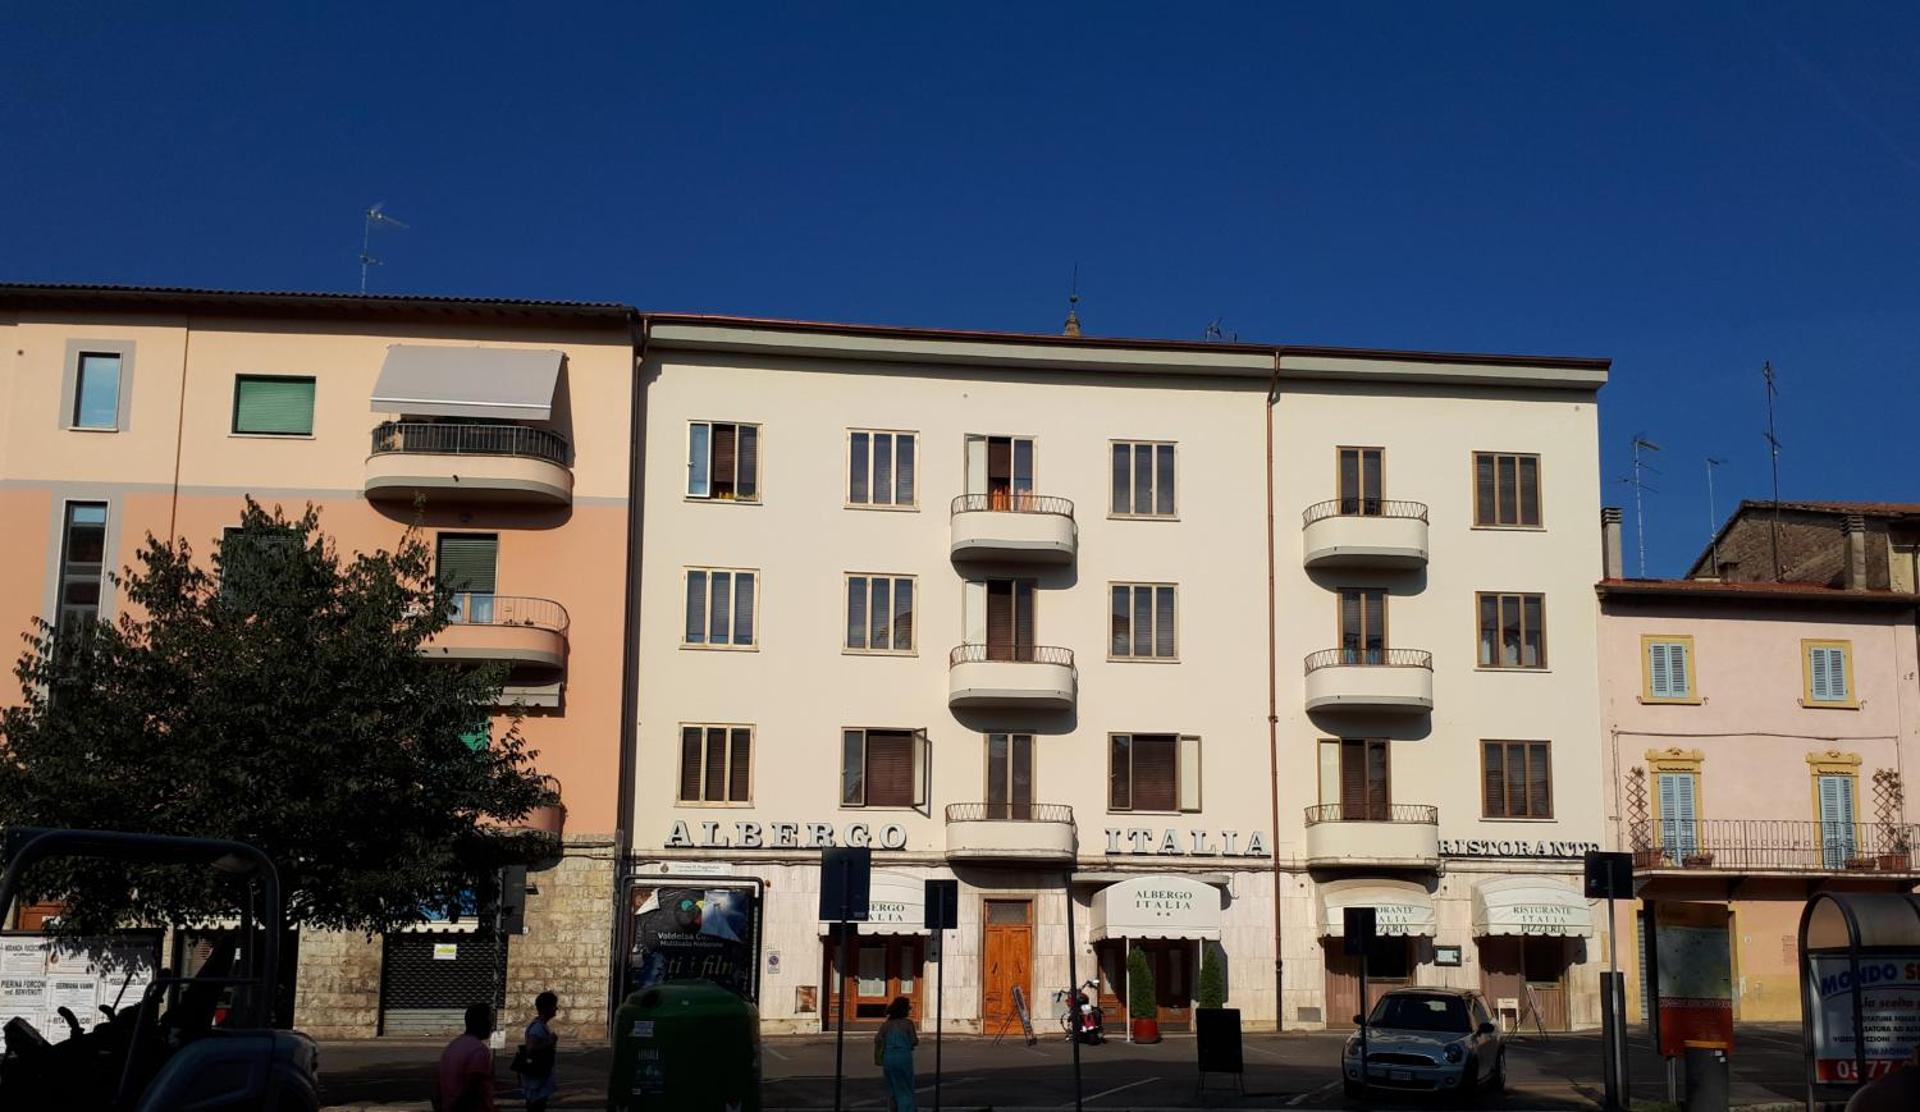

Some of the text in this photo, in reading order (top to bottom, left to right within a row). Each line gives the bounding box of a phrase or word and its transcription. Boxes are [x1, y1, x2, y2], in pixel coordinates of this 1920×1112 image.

[664, 819, 908, 850] ALBERGO
[1105, 828, 1272, 858] ITALIA
[1437, 839, 1600, 859] RISTORANTE
[1135, 890, 1193, 900] ALBERGO
[871, 903, 905, 912] ERGO
[1135, 900, 1192, 910] ITALIA
[1376, 906, 1414, 914] ORANTE
[1513, 906, 1570, 915] RISTORANTE
[869, 913, 904, 921] ALIA
[1522, 915, 1566, 923] ITALIA
[1378, 924, 1410, 933] ZERIA
[1521, 924, 1568, 933] PIZZERIA
[1822, 963, 1897, 995] MONDO
